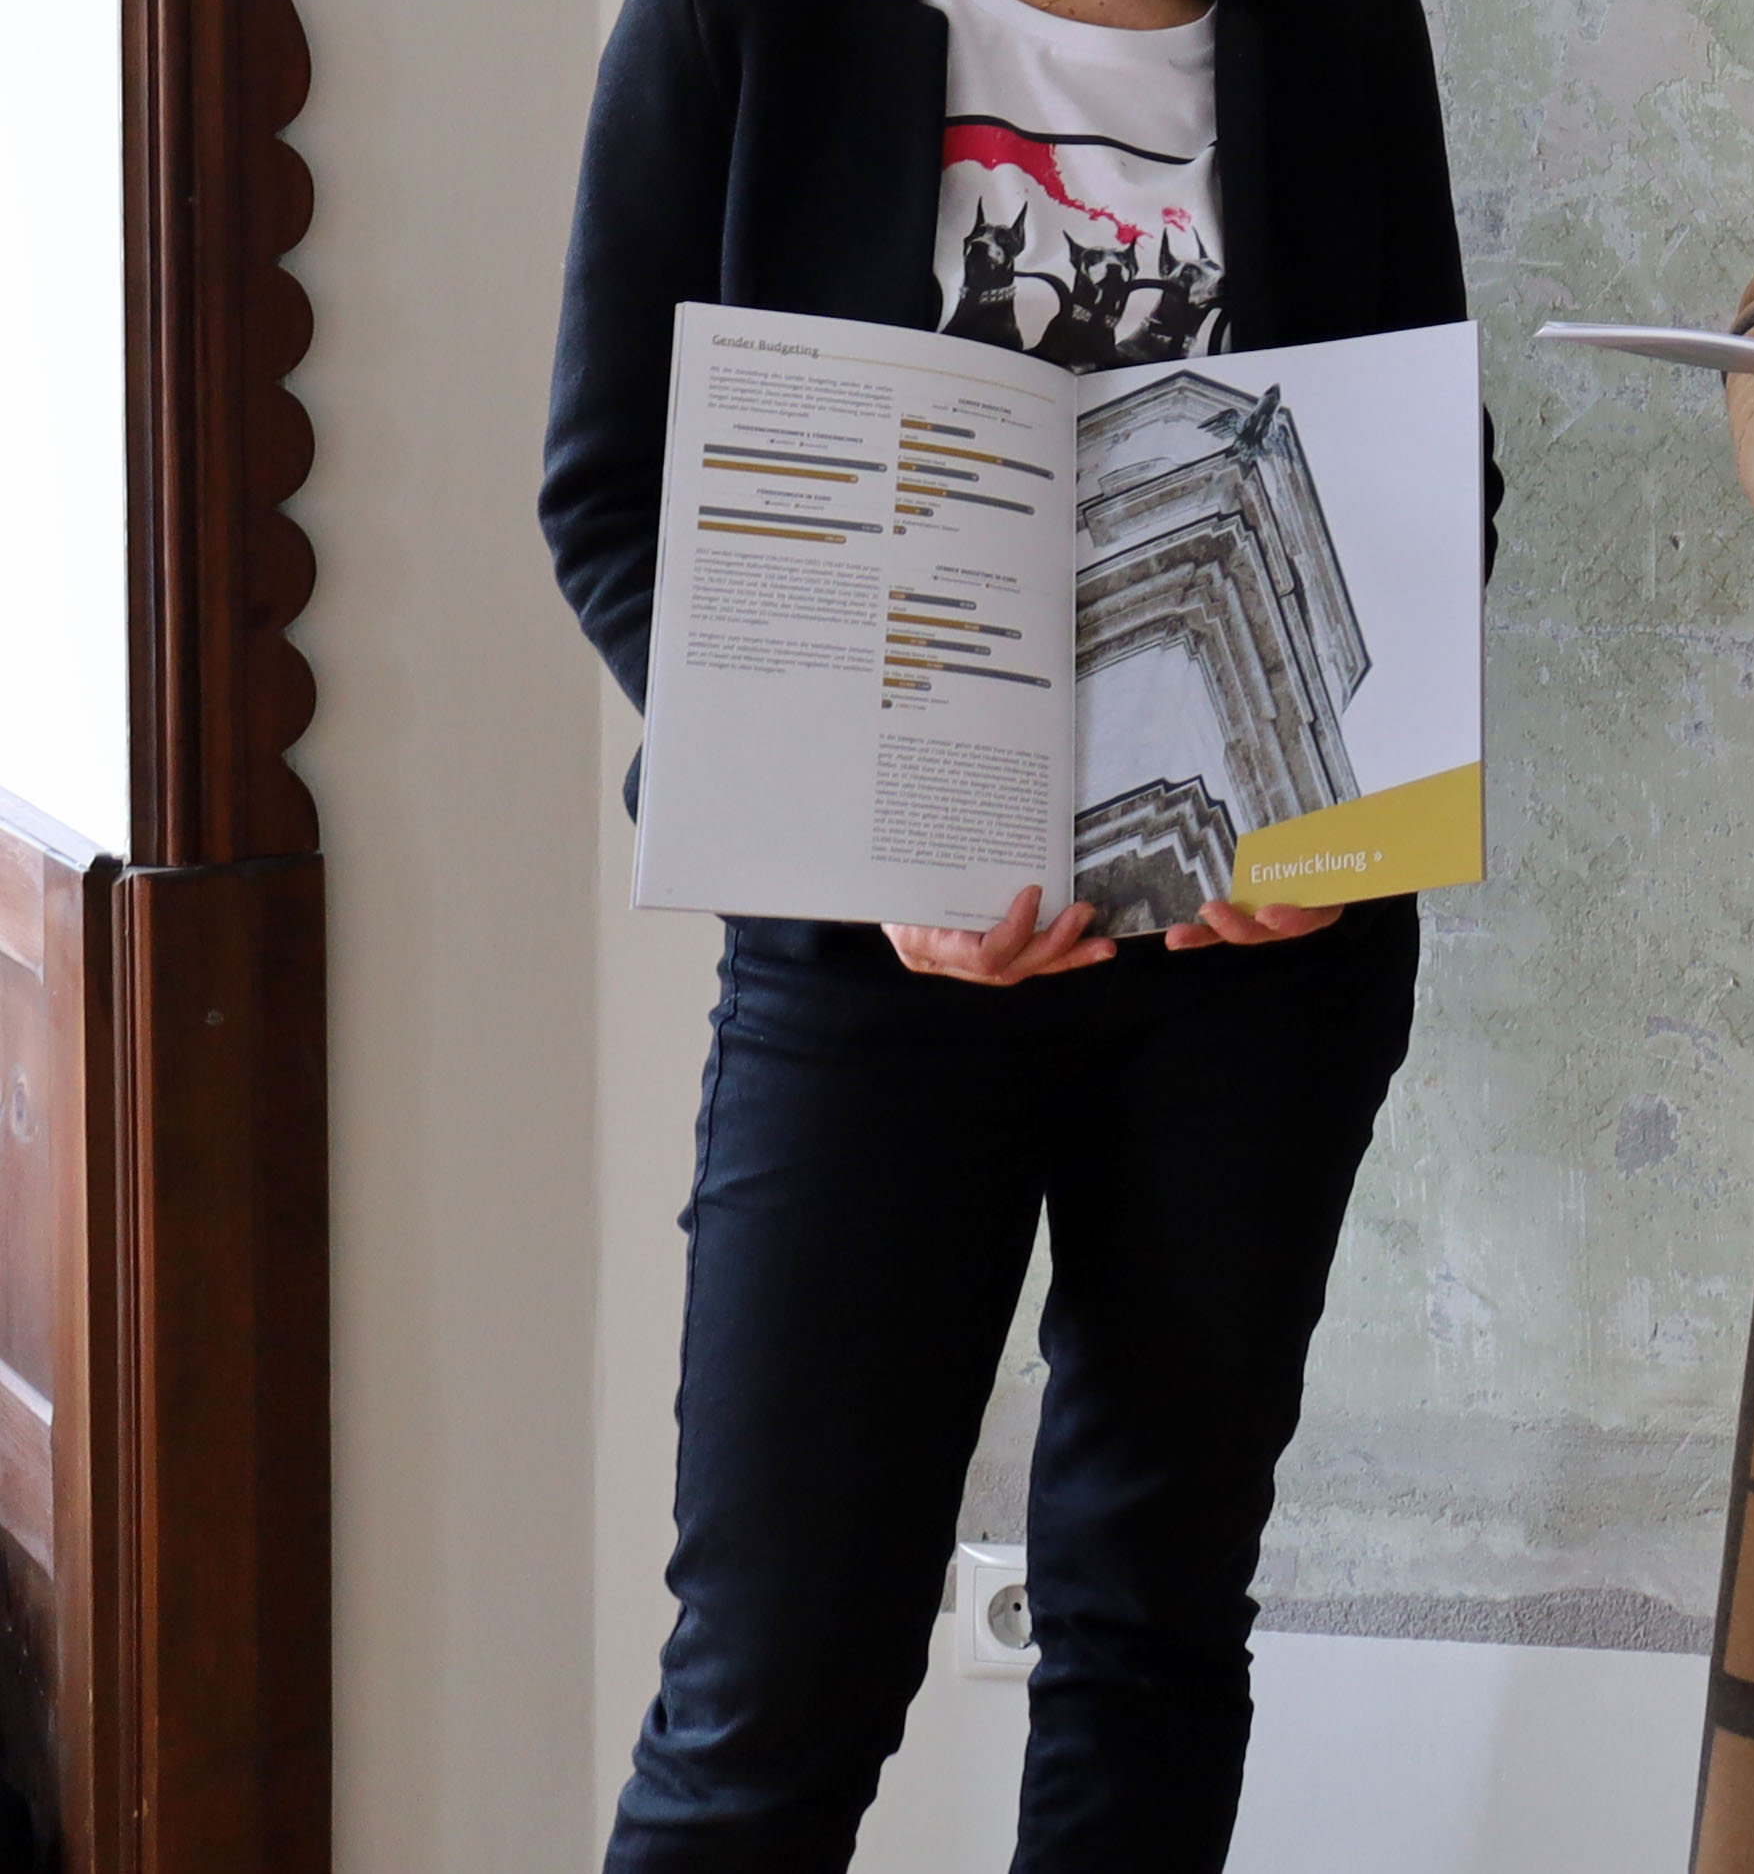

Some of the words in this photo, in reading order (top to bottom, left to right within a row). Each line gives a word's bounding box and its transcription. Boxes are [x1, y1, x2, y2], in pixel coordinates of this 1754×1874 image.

[711, 333, 755, 350] Gender
[757, 338, 820, 359] Budgeting
[1250, 850, 1368, 884] Entwicklung
